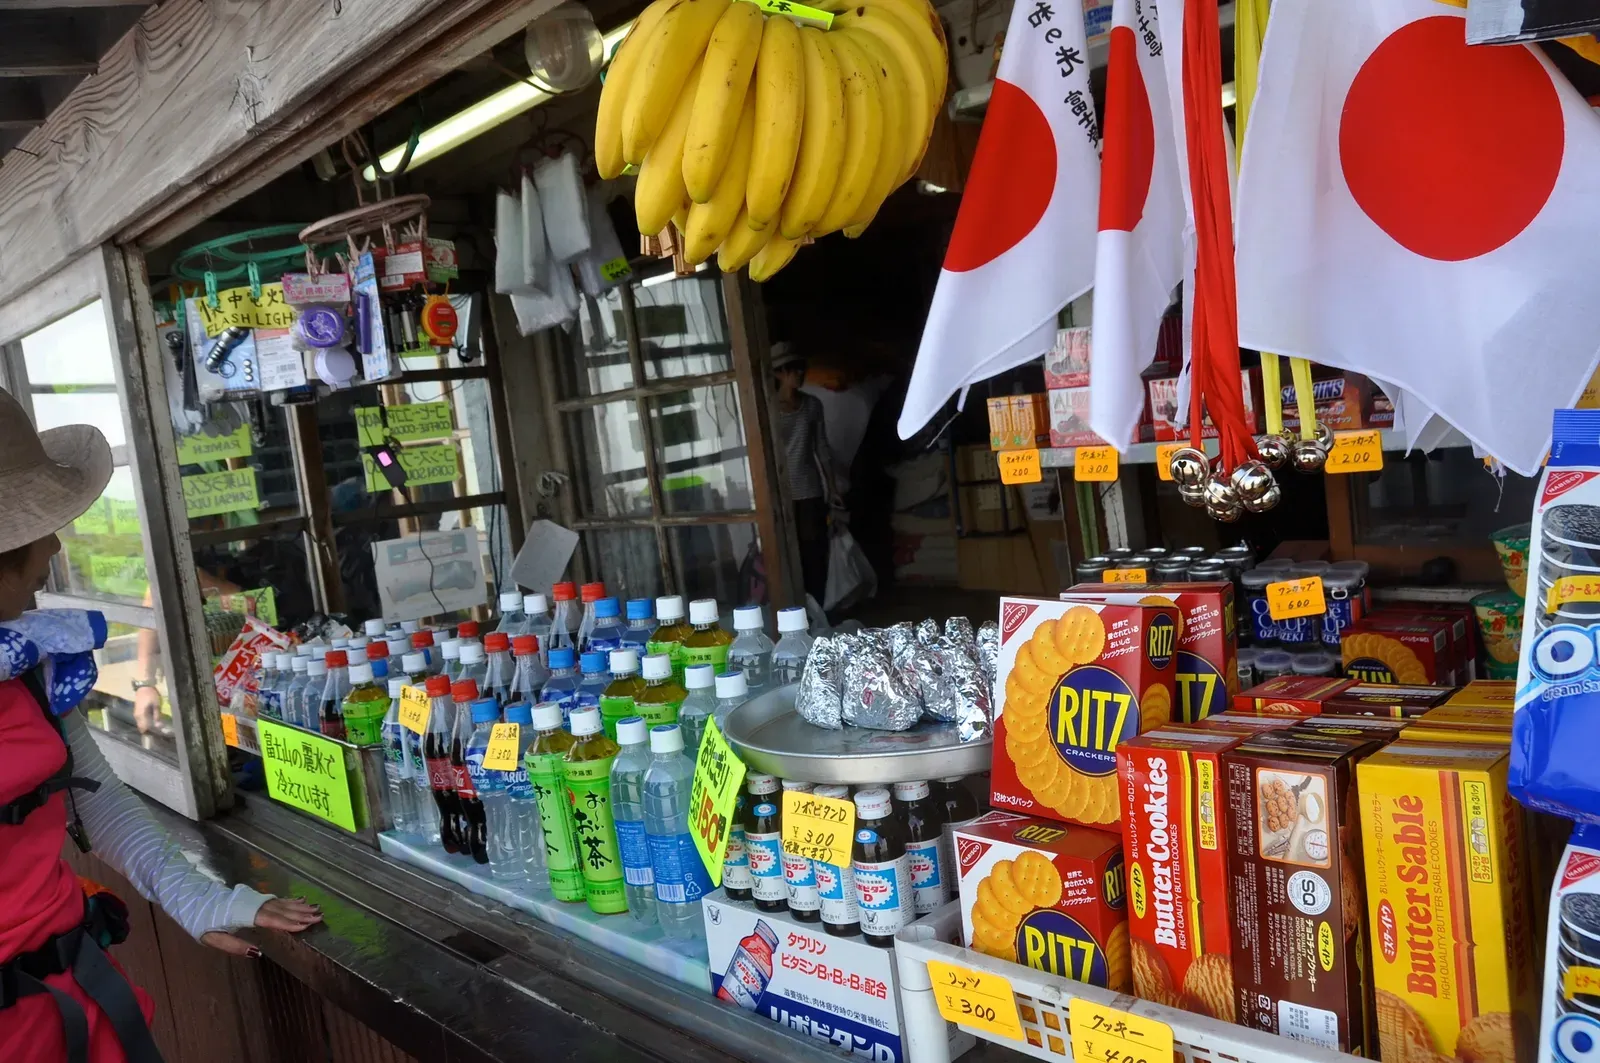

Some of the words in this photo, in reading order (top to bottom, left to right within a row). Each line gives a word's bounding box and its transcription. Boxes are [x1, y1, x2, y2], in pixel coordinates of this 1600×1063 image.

[206, 313, 250, 337] FLASH
[256, 311, 294, 326] LIGH
[1088, 464, 1109, 474] 300
[1342, 452, 1370, 463] 200
[1012, 468, 1029, 477] 200
[1548, 473, 1583, 494] NABISCO
[1190, 604, 1208, 615] 世界で
[1288, 599, 1310, 609] 600
[1005, 607, 1027, 631] NABISCO
[1112, 619, 1129, 630] 世界で
[1186, 609, 1219, 626] 愛されている
[1190, 620, 1212, 633] おいしさ
[1107, 626, 1139, 640] 愛されている
[1110, 638, 1131, 649] おいしさ
[1149, 625, 1174, 657] RITZ
[1175, 673, 1218, 723] TZ
[1057, 685, 1132, 753] RITZ
[1065, 748, 1117, 763] CRACKERS
[793, 800, 847, 822] リポビタンD
[1143, 756, 1171, 862] Cookies
[573, 807, 613, 870] お茶
[804, 829, 835, 847] 300
[1015, 824, 1066, 843] RITZ
[1170, 823, 1179, 860] COOKIES
[1391, 794, 1429, 885] Sablé
[1428, 820, 1440, 862] COOKIES
[751, 860, 759, 870] D
[962, 844, 981, 864] NABISCO
[786, 870, 794, 878] D
[1066, 870, 1083, 878] 世界で
[1173, 859, 1181, 894] BUTTER
[863, 893, 874, 902] D
[1067, 888, 1088, 897] おいしさ
[1302, 879, 1316, 906] SQ
[1154, 861, 1178, 949] Butter
[1176, 893, 1186, 928] QUALITY
[1434, 895, 1445, 933] BUTTER
[787, 932, 827, 955] タウリン
[1179, 927, 1187, 950] HIGH
[1405, 888, 1438, 998] Butter
[1024, 924, 1096, 985] RITZ
[1305, 918, 1317, 993] チョコチップクッキー
[1437, 934, 1449, 976] QUALITY
[948, 971, 981, 989] リッツ
[1441, 976, 1451, 1000] HIGH
[960, 997, 997, 1022] 300
[1091, 1013, 1145, 1039] クッキー
